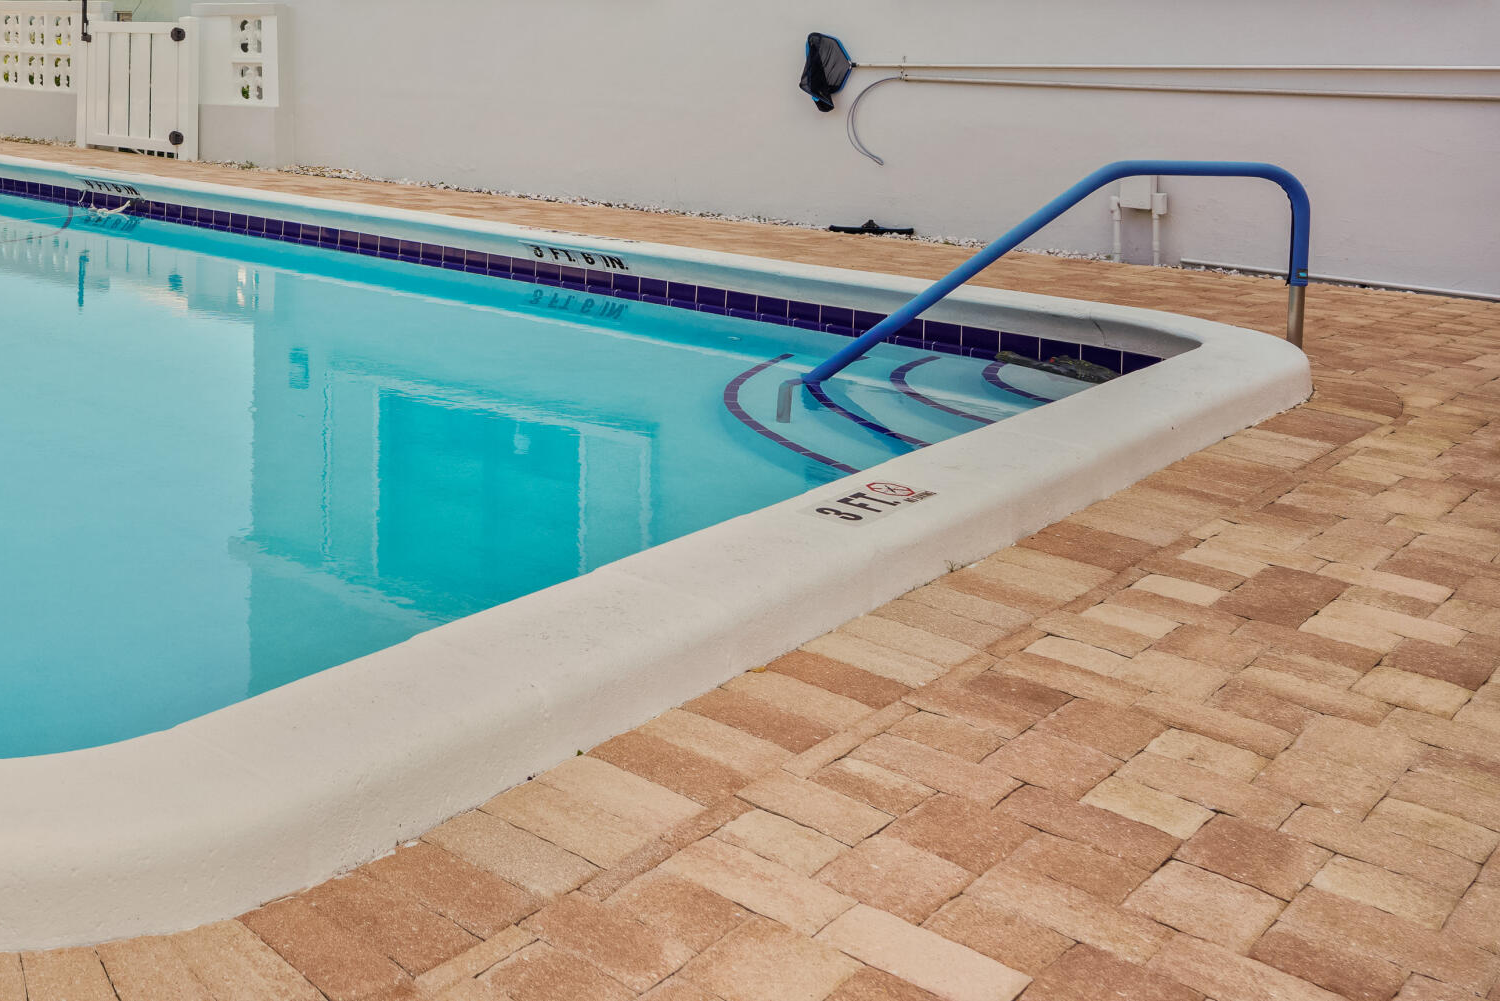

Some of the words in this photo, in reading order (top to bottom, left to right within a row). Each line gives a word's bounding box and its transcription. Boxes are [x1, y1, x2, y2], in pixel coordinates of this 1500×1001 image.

[548, 247, 576, 262] FT.
[580, 251, 596, 265] 6
[601, 254, 629, 270] IN.
[836, 491, 902, 513] FT.
[815, 507, 864, 521] 3
